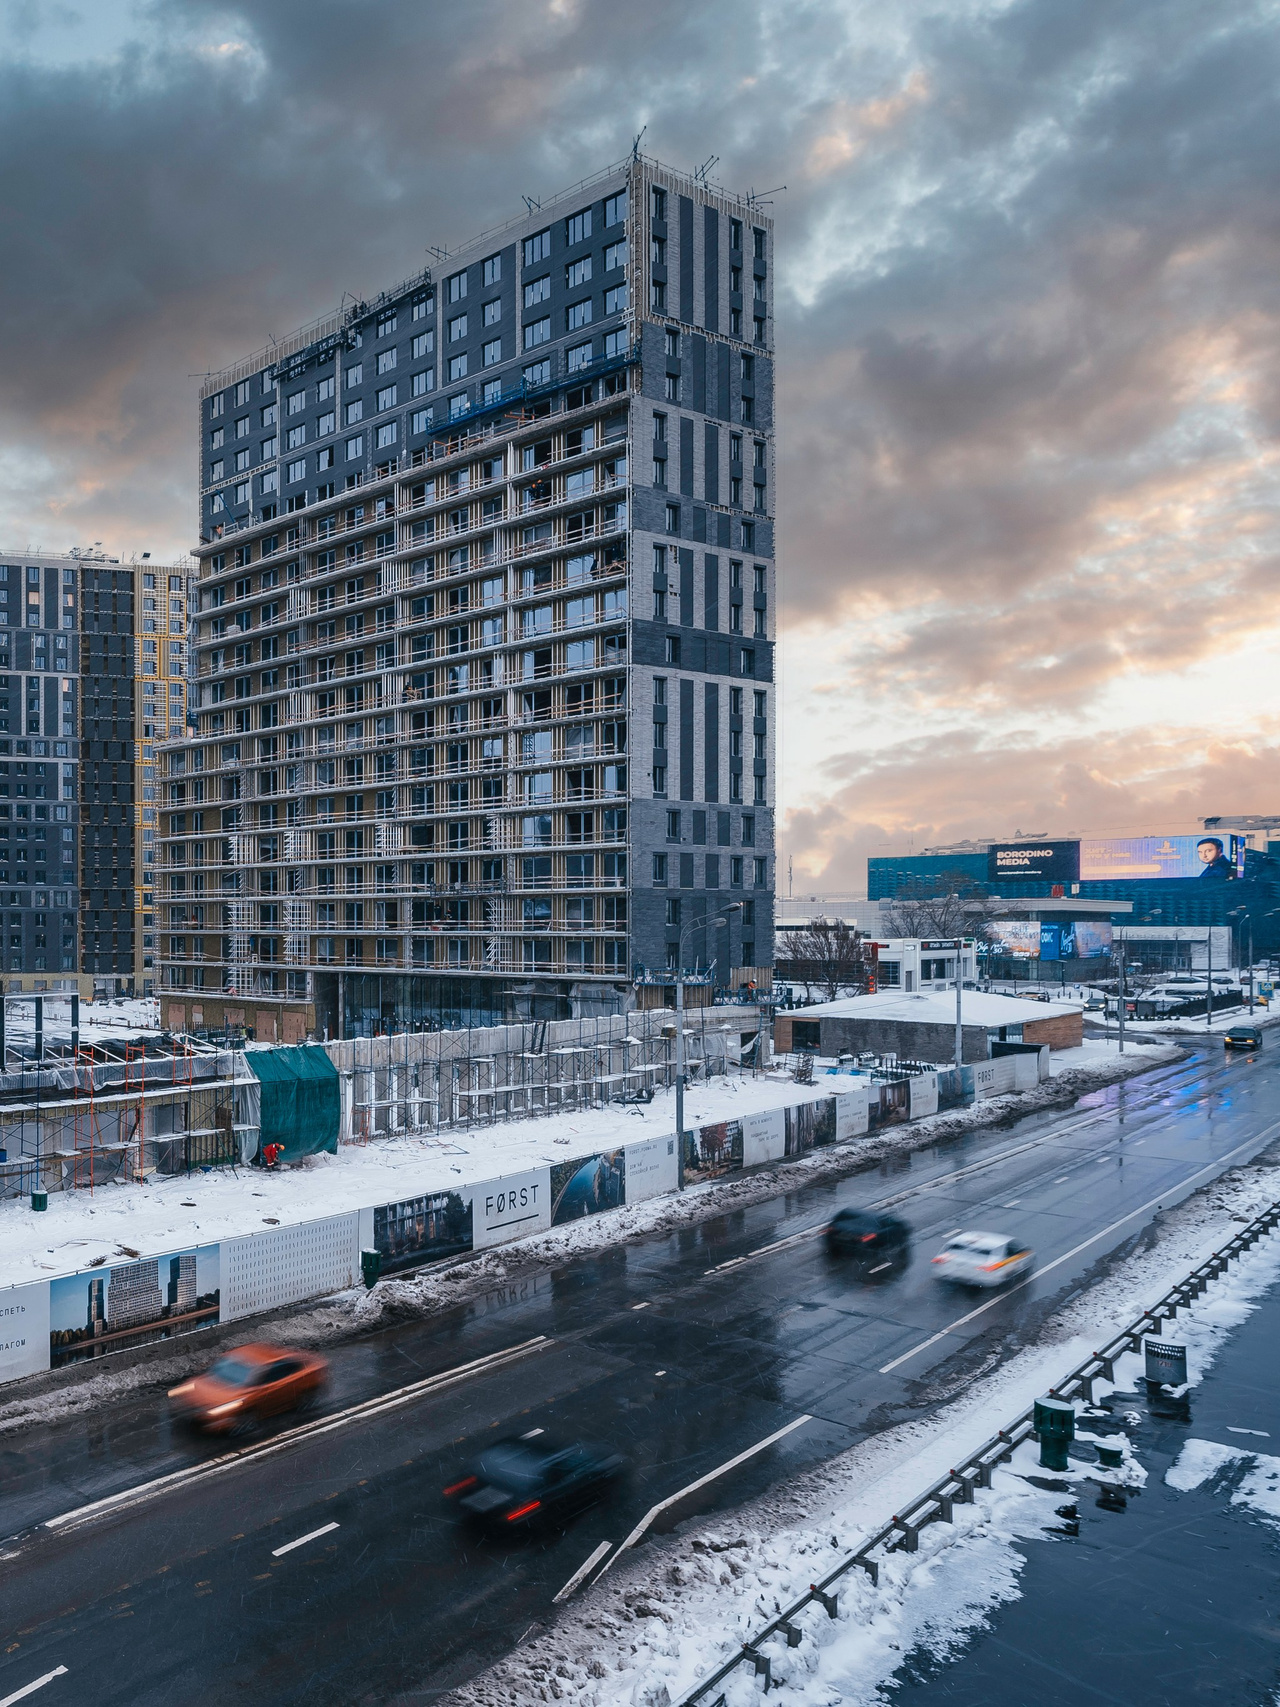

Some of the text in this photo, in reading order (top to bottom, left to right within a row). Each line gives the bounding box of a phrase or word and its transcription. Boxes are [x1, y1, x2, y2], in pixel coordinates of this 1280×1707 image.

[996, 850, 1053, 858] BORODINO
[996, 858, 1030, 866] MEDIA
[486, 1184, 539, 1217] FØRST
